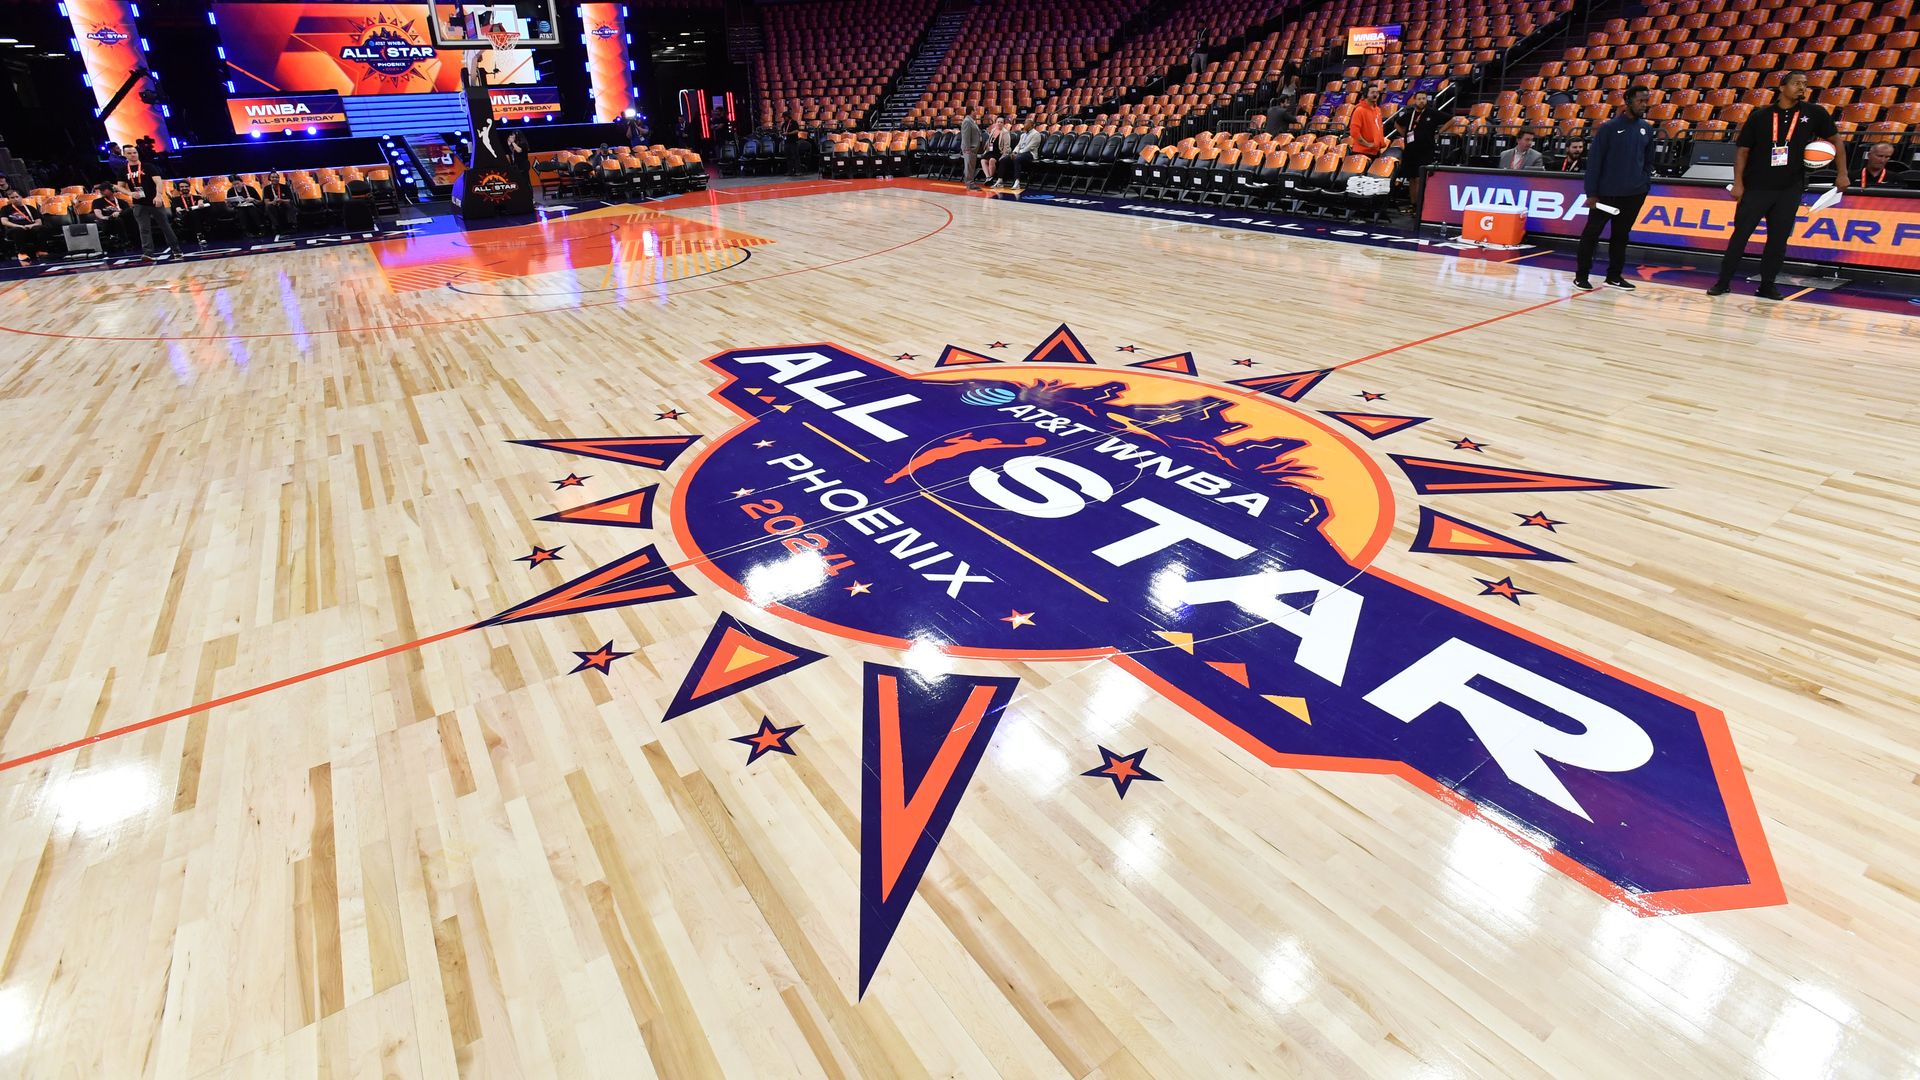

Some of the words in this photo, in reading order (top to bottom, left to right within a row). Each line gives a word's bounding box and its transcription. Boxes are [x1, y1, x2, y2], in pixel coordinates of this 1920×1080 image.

[342, 48, 379, 58] ALL
[387, 47, 433, 57] STAR
[1353, 32, 1386, 42] WNBA
[244, 102, 311, 117] WNBA
[251, 116, 300, 125] ALL-STAR
[300, 114, 335, 122] FRIDAY
[494, 183, 517, 191] STAR
[1448, 184, 1591, 221] WNBA
[1219, 216, 1305, 231] ALL
[1330, 228, 1480, 250] STAR
[1480, 215, 1494, 231] G
[1640, 205, 1881, 244] ALL-AR
[733, 351, 923, 443] ALL
[997, 403, 1097, 437] AT&T
[1093, 436, 1271, 518] WNBA
[740, 499, 856, 577] 2024
[766, 452, 995, 599] PHOENIX
[968, 454, 1655, 824] STAR
